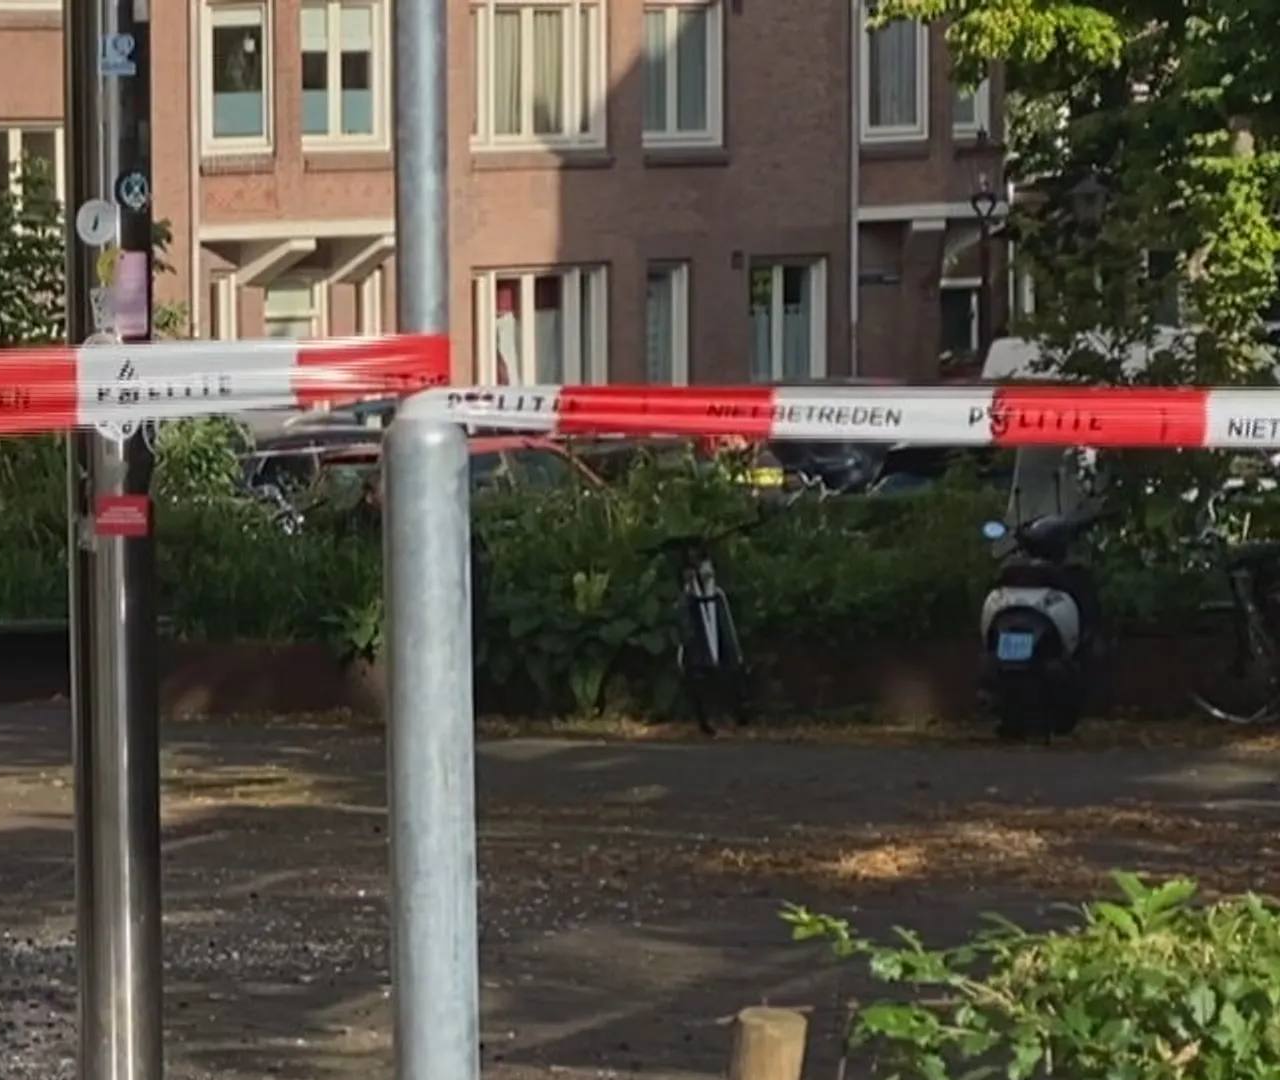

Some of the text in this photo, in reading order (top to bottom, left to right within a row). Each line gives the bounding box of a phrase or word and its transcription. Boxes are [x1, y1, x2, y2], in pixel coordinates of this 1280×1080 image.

[706, 403, 902, 427] NIET BETREDEN
[1226, 416, 1280, 441] NIET
